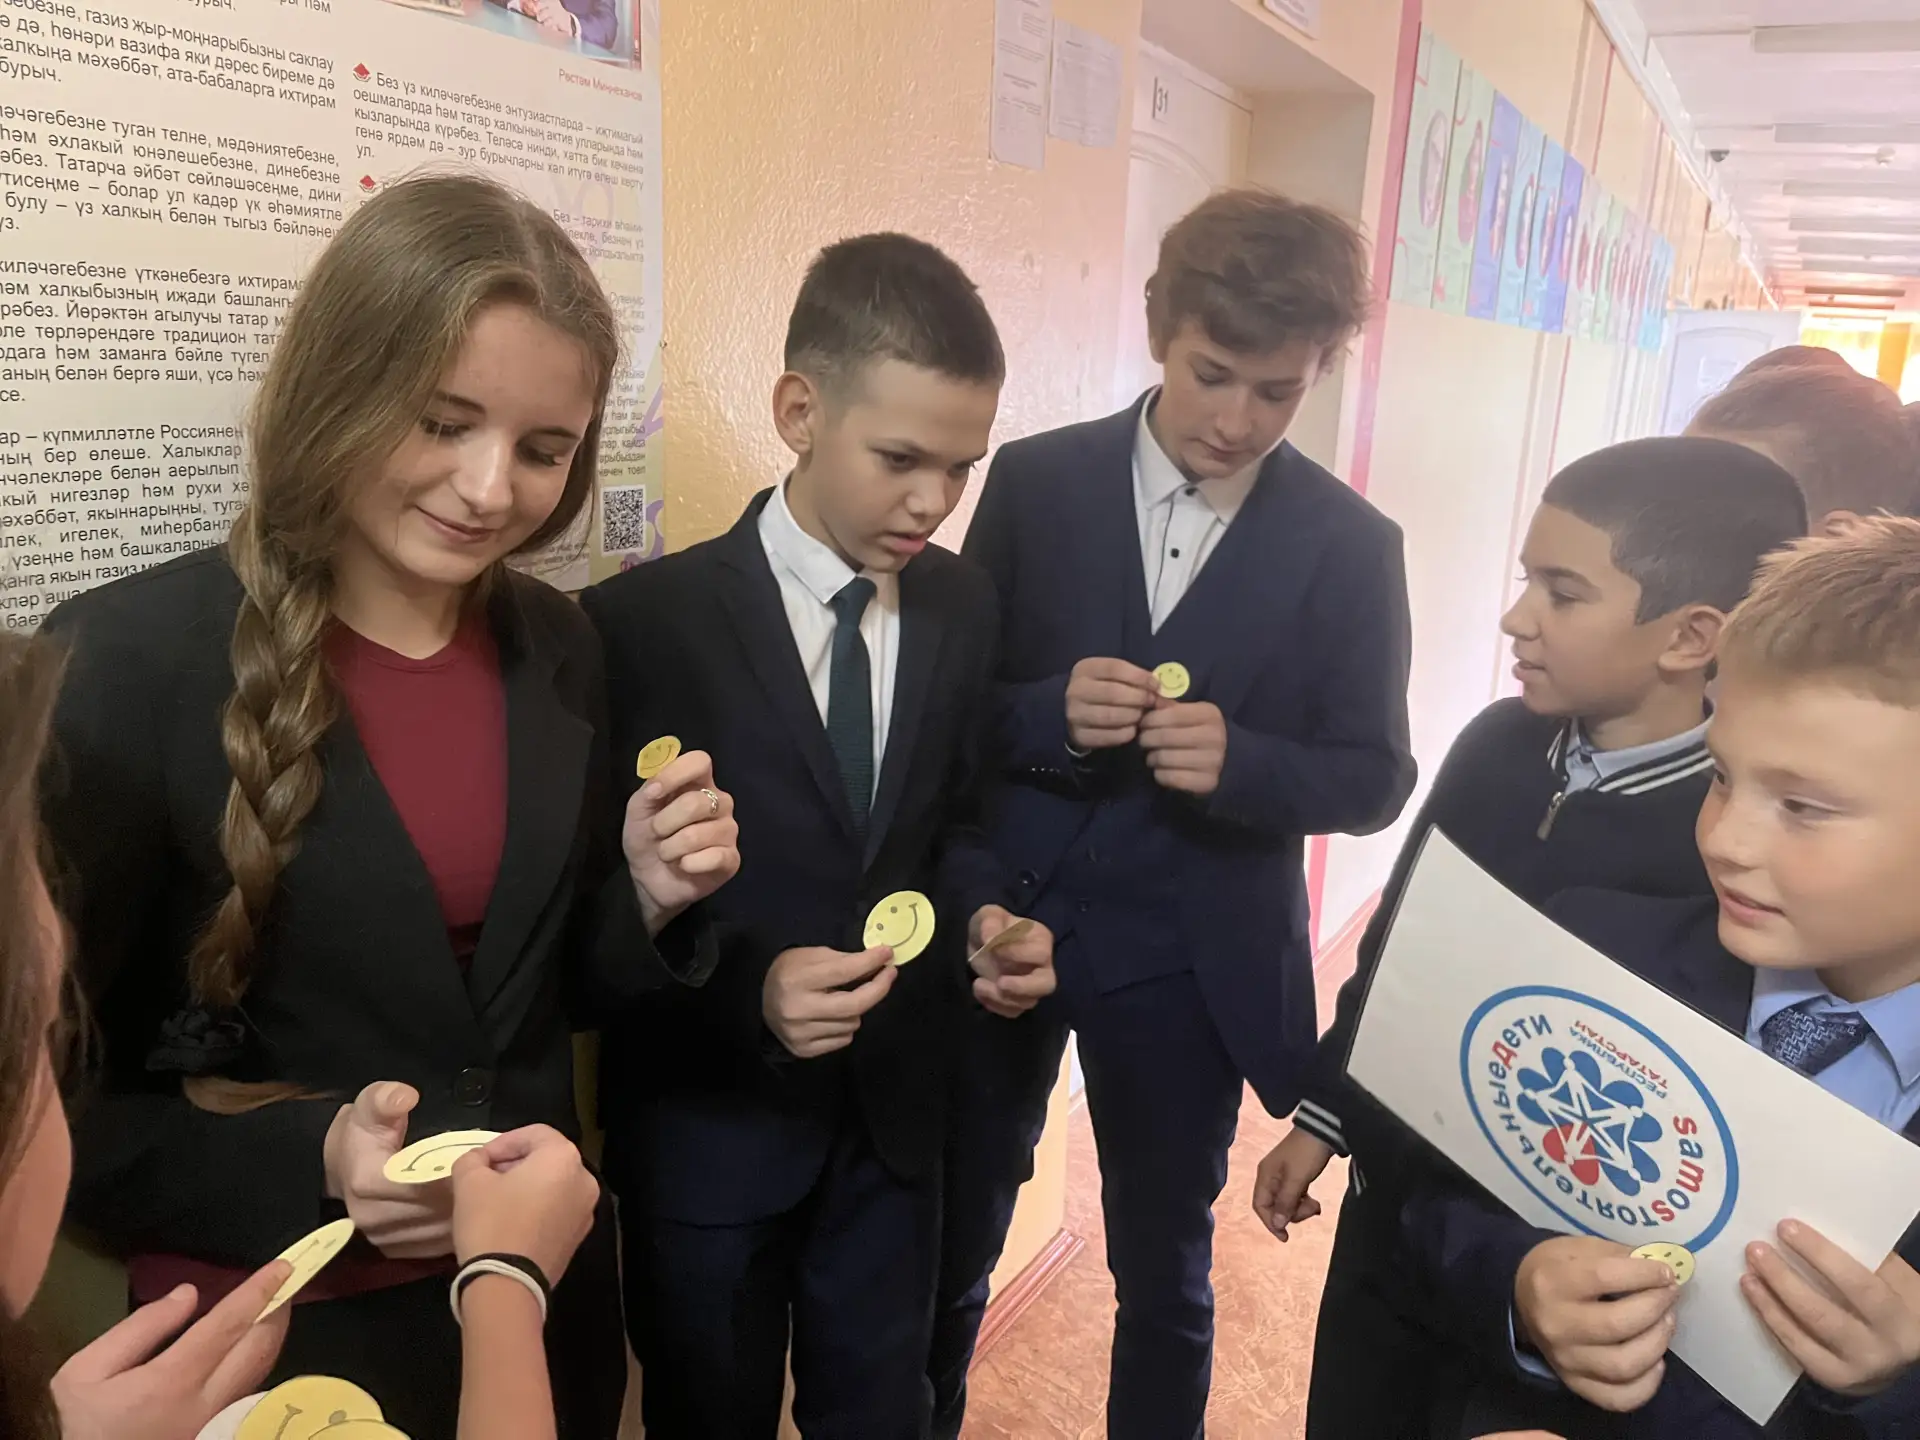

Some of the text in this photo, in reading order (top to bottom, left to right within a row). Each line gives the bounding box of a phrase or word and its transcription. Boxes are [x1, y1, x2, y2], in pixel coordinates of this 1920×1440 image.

[17, 18, 45, 37] дә,
[51, 20, 114, 48] һөнәри
[120, 38, 180, 61] вазифа
[185, 50, 210, 66] яки
[214, 56, 258, 76] дәрес
[262, 62, 315, 86] биреме
[318, 77, 335, 91] дә
[86, 9, 128, 29] газиз
[132, 18, 286, 61] җыр-моңнарыбызны
[288, 50, 334, 74] саклау
[0, 56, 62, 82] бурыч.
[78, 51, 162, 80] мәхәббәт,
[166, 67, 275, 98] ата-бабаларга
[279, 88, 336, 108] ихтирам
[376, 72, 399, 90] Без
[403, 81, 416, 95] үз
[420, 85, 502, 112] киләчәгебезне
[354, 89, 432, 116] оешмаларда
[436, 102, 458, 121] һәм
[461, 112, 491, 132] татар
[494, 118, 545, 141] халкының
[547, 130, 574, 144] актив
[112, 121, 156, 138] туган
[161, 128, 212, 148] телне,
[217, 136, 340, 167] мәдәниятебезне,
[354, 108, 430, 132] кызларында
[435, 124, 482, 143] күрәбез.
[487, 131, 524, 151] Теләсә
[528, 144, 560, 160] нинди,
[563, 150, 589, 165] хәтта
[592, 153, 608, 168] бик
[356, 126, 384, 142] генә
[387, 132, 426, 150] ярдәм
[429, 140, 444, 153] дә
[458, 146, 476, 160] зур
[480, 147, 544, 170] бурычларны
[548, 163, 564, 176] хәл
[356, 144, 375, 159] ул.
[0, 124, 340, 184] һәм әхлакый юнәлешебезне, динебезне
[56, 152, 126, 176] Татарча
[133, 164, 180, 182] әйбәт
[188, 172, 303, 200] сөйләшәсеңме,
[308, 188, 342, 203] дини
[5, 192, 48, 214] булу
[75, 201, 94, 217] үз
[102, 203, 163, 224] халкың
[169, 206, 216, 226] белән
[224, 216, 268, 231] тыгыз
[108, 180, 158, 202] болар
[166, 190, 185, 205] ул
[194, 192, 238, 212] кадәр
[246, 200, 262, 214] үк
[268, 200, 342, 222] әһәмиятле
[135, 268, 230, 286] үткәнебезгә
[40, 283, 158, 303] халкыбызның
[166, 290, 216, 305] иҗади
[66, 299, 148, 322] Йөрәктән
[154, 309, 222, 326] агылучы
[228, 313, 268, 328] татар
[34, 326, 155, 342] төрләрендәге
[163, 329, 246, 345] традицион
[56, 344, 90, 360] һәм
[100, 348, 166, 360] заманга
[175, 346, 223, 362] бәйле
[231, 352, 269, 365] түгел
[2, 368, 50, 383] аның
[56, 364, 108, 380] белән
[114, 365, 160, 384] бергә
[166, 369, 202, 382] яши,
[207, 369, 233, 384] үсә
[43, 428, 154, 446] күпмилләтле
[44, 447, 76, 465] бер
[90, 448, 151, 461] өлеше.
[162, 444, 242, 460] Халыклар
[110, 465, 160, 480] белән
[168, 463, 240, 479] аерылып
[0, 490, 36, 507] кый
[50, 488, 130, 503] нигезләр
[142, 483, 174, 498] һәм
[186, 483, 222, 498] рухи
[0, 508, 79, 528] әхәббәт,
[87, 502, 206, 520] якыннарыңны,
[0, 518, 234, 549] лек, игелек, миһербанл
[12, 550, 74, 570] үзеңне
[80, 546, 114, 561] һәм
[50, 570, 92, 584] якын
[96, 564, 138, 579] газиз
